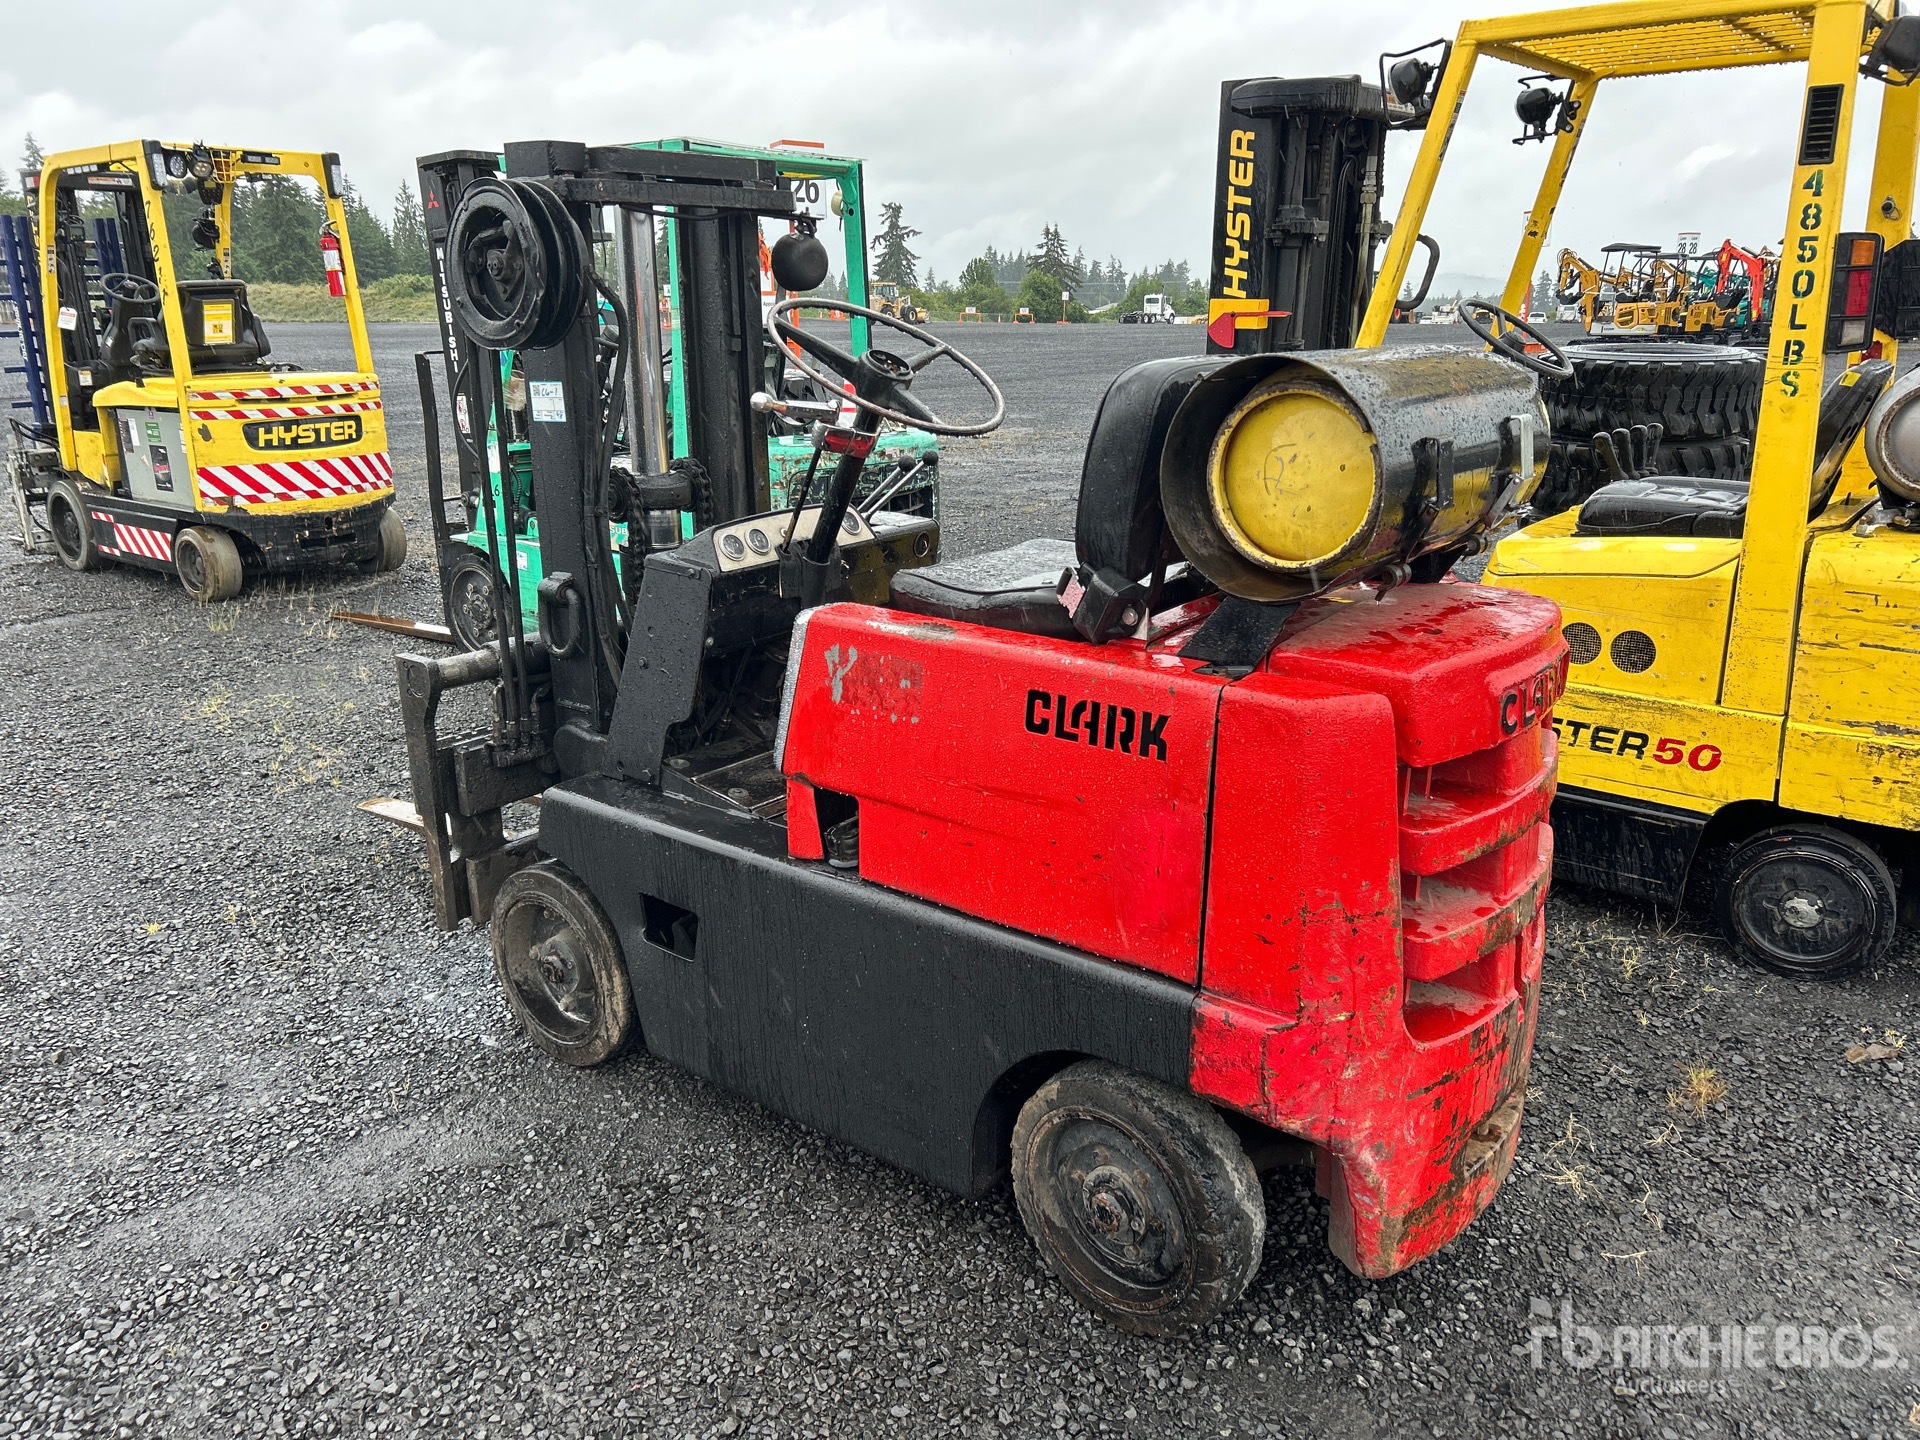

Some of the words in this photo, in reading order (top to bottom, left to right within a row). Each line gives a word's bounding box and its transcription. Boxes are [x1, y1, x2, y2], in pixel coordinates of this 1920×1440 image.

[1223, 129, 1256, 299] HYSTER
[435, 247, 458, 373] MITSUBISHI
[258, 420, 357, 447] HYSTER
[1025, 688, 1171, 763] CLARK
[1652, 737, 1722, 772] 50
